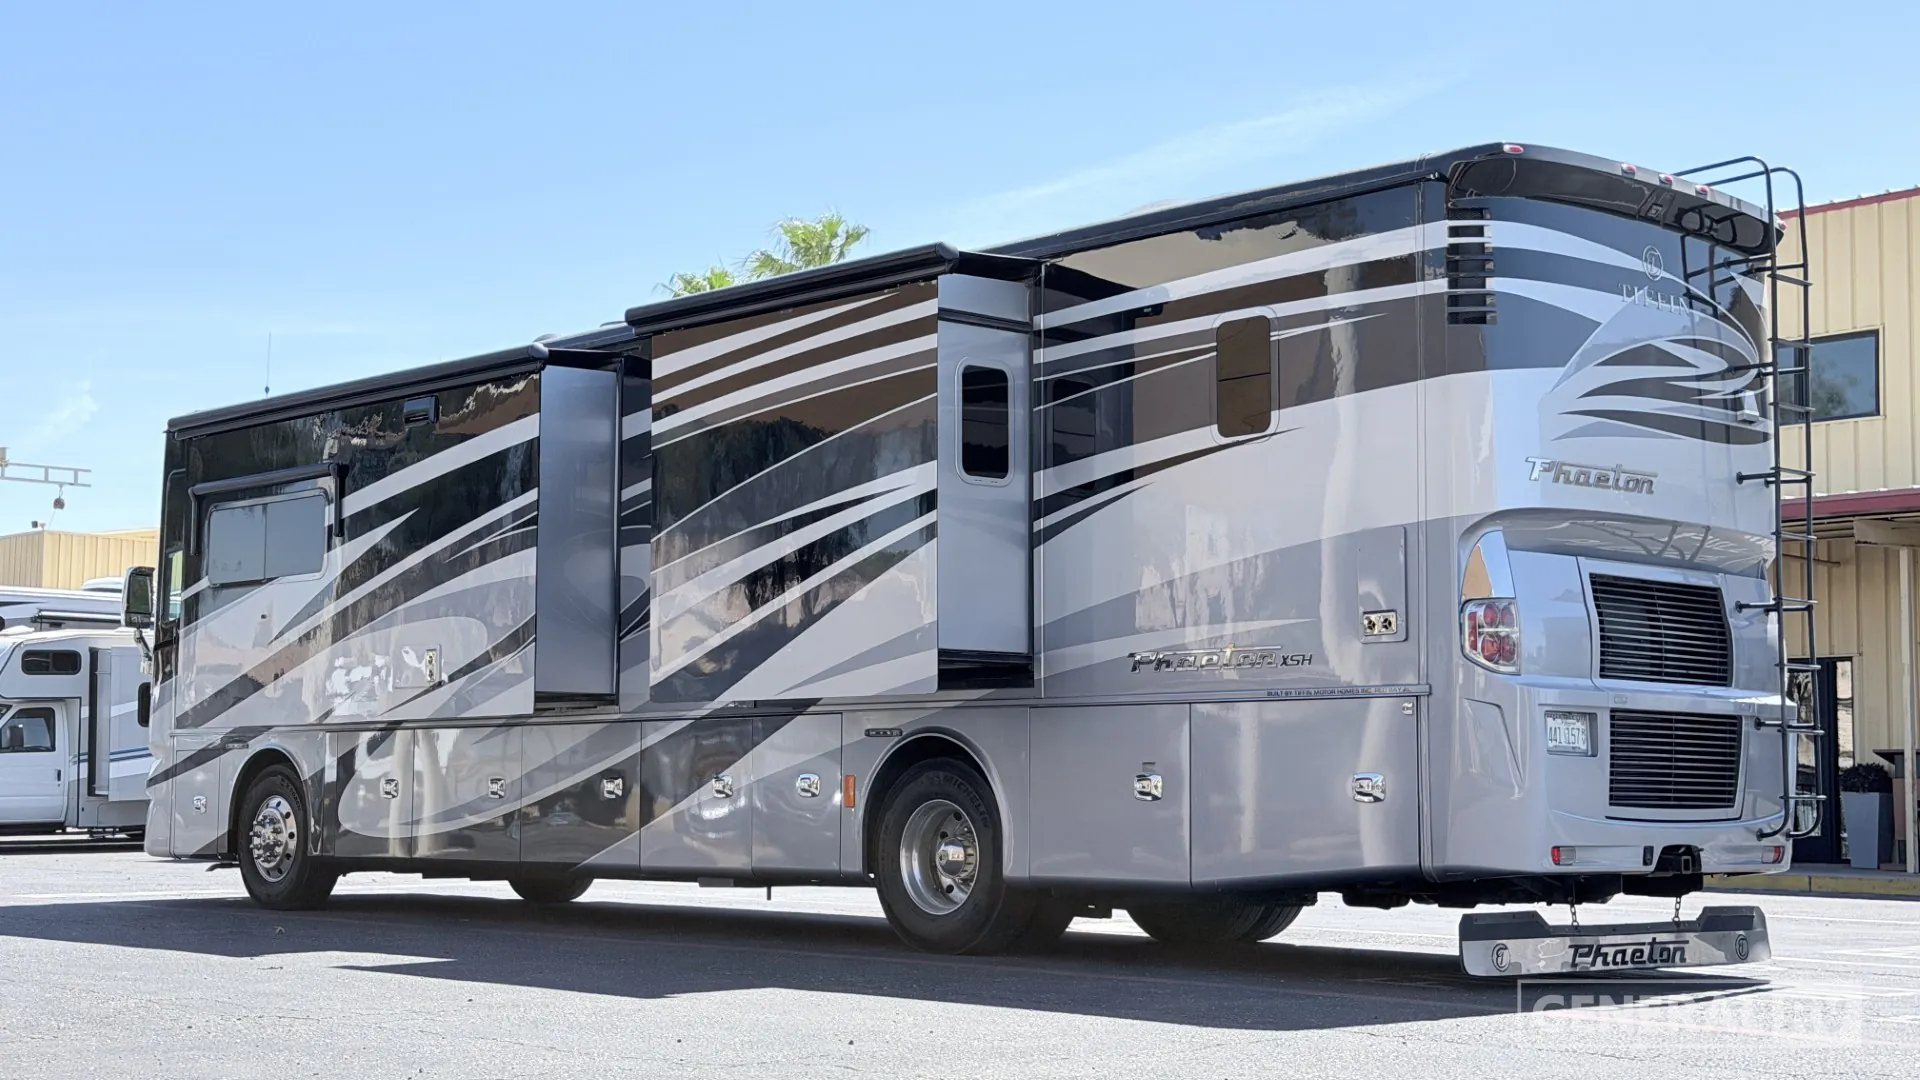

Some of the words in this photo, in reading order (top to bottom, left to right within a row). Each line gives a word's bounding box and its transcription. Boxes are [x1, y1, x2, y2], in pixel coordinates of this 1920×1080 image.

[1618, 283, 1692, 317] TIFFIN
[1525, 456, 1658, 495] Phaeton
[1128, 642, 1282, 673] Phaeton
[1280, 653, 1312, 667] XSH
[1548, 726, 1562, 745] 441
[1568, 936, 1690, 968] Phaeton
